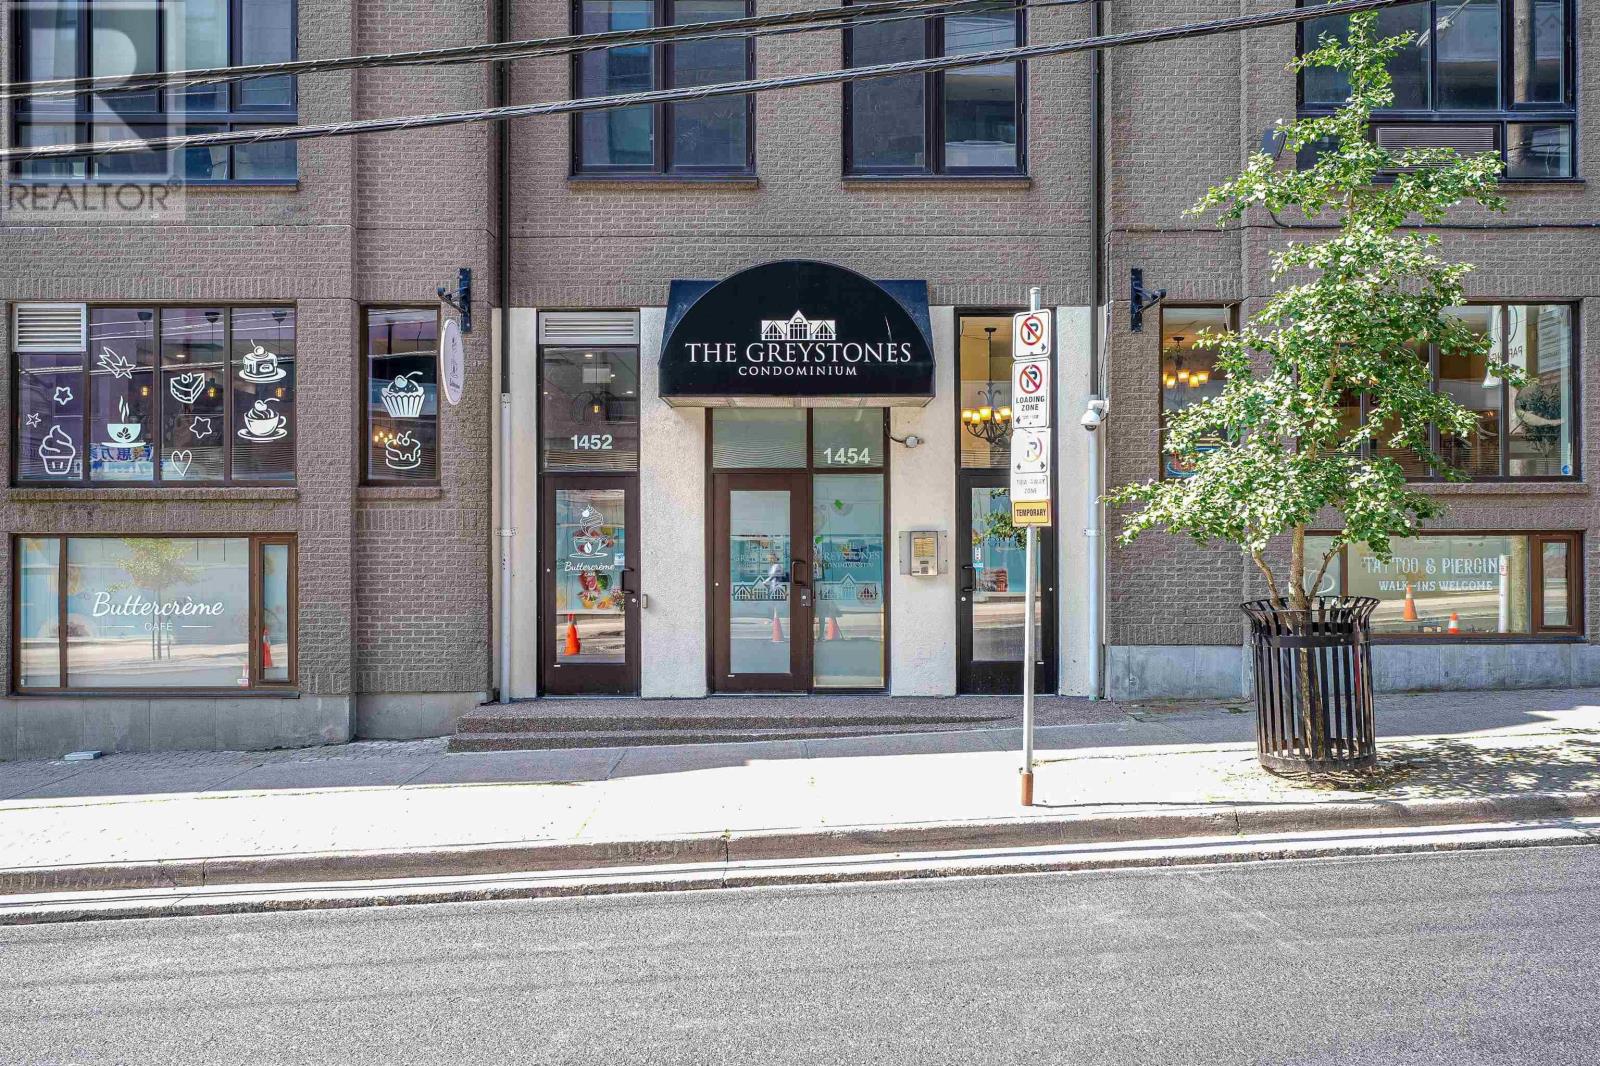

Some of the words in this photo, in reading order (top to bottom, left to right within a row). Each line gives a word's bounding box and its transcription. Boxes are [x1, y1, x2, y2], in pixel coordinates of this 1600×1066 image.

[685, 342, 737, 363] THE
[746, 342, 911, 364] GREYSTONES
[738, 366, 857, 376] CONDOMINIUM
[1016, 395, 1045, 404] LOADING
[1021, 403, 1039, 411] ZONE
[570, 434, 613, 450] 1452
[823, 447, 871, 465] 1454
[1016, 508, 1046, 517] TEMPORARY
[1425, 557, 1437, 575] &
[1442, 557, 1499, 575] PIERCIN
[1438, 580, 1494, 591] WELCOME
[92, 591, 225, 617] Buttercrème
